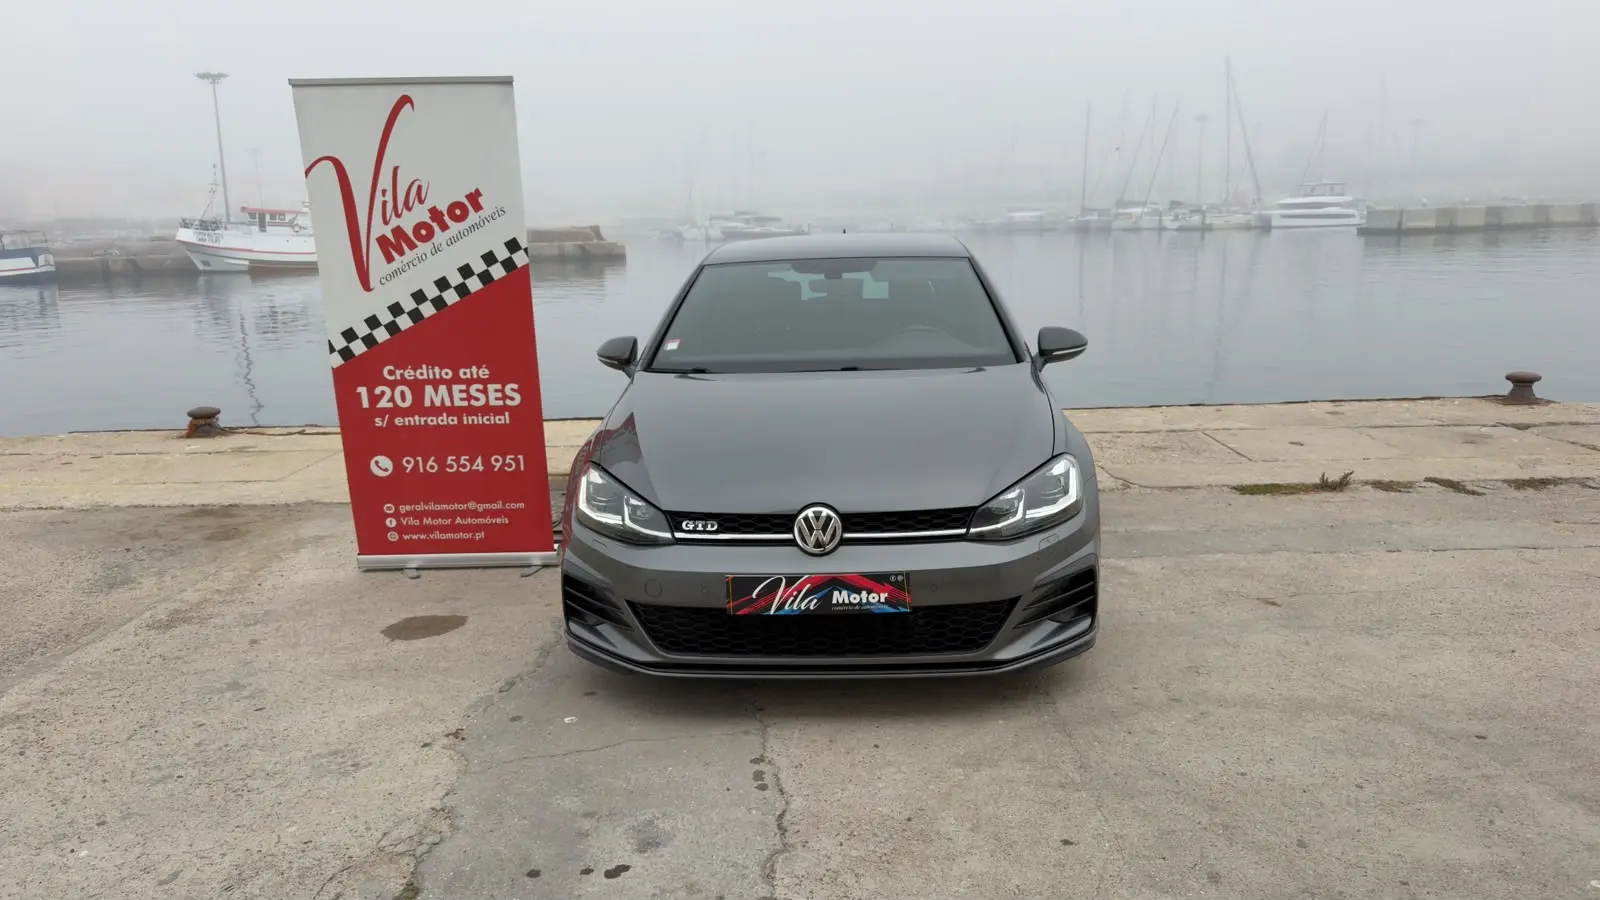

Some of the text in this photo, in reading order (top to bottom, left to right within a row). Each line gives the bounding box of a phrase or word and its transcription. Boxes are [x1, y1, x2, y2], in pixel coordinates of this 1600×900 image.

[305, 94, 430, 293] Vila
[375, 187, 484, 265] Motor
[379, 206, 507, 286] comércio de automóveis
[382, 364, 490, 380] Crédito até
[356, 383, 521, 408] 120 MESES
[374, 412, 510, 427] s/ entrada inicial
[402, 455, 525, 473] 916 554 951
[399, 501, 525, 513] geralvilamotor@gmail.com
[400, 515, 509, 526] Vila Motor Automóveis
[681, 520, 718, 531] GTD
[402, 530, 485, 541] www.vilamotor.pt
[752, 575, 823, 615] Vila
[831, 590, 888, 604] Motor
